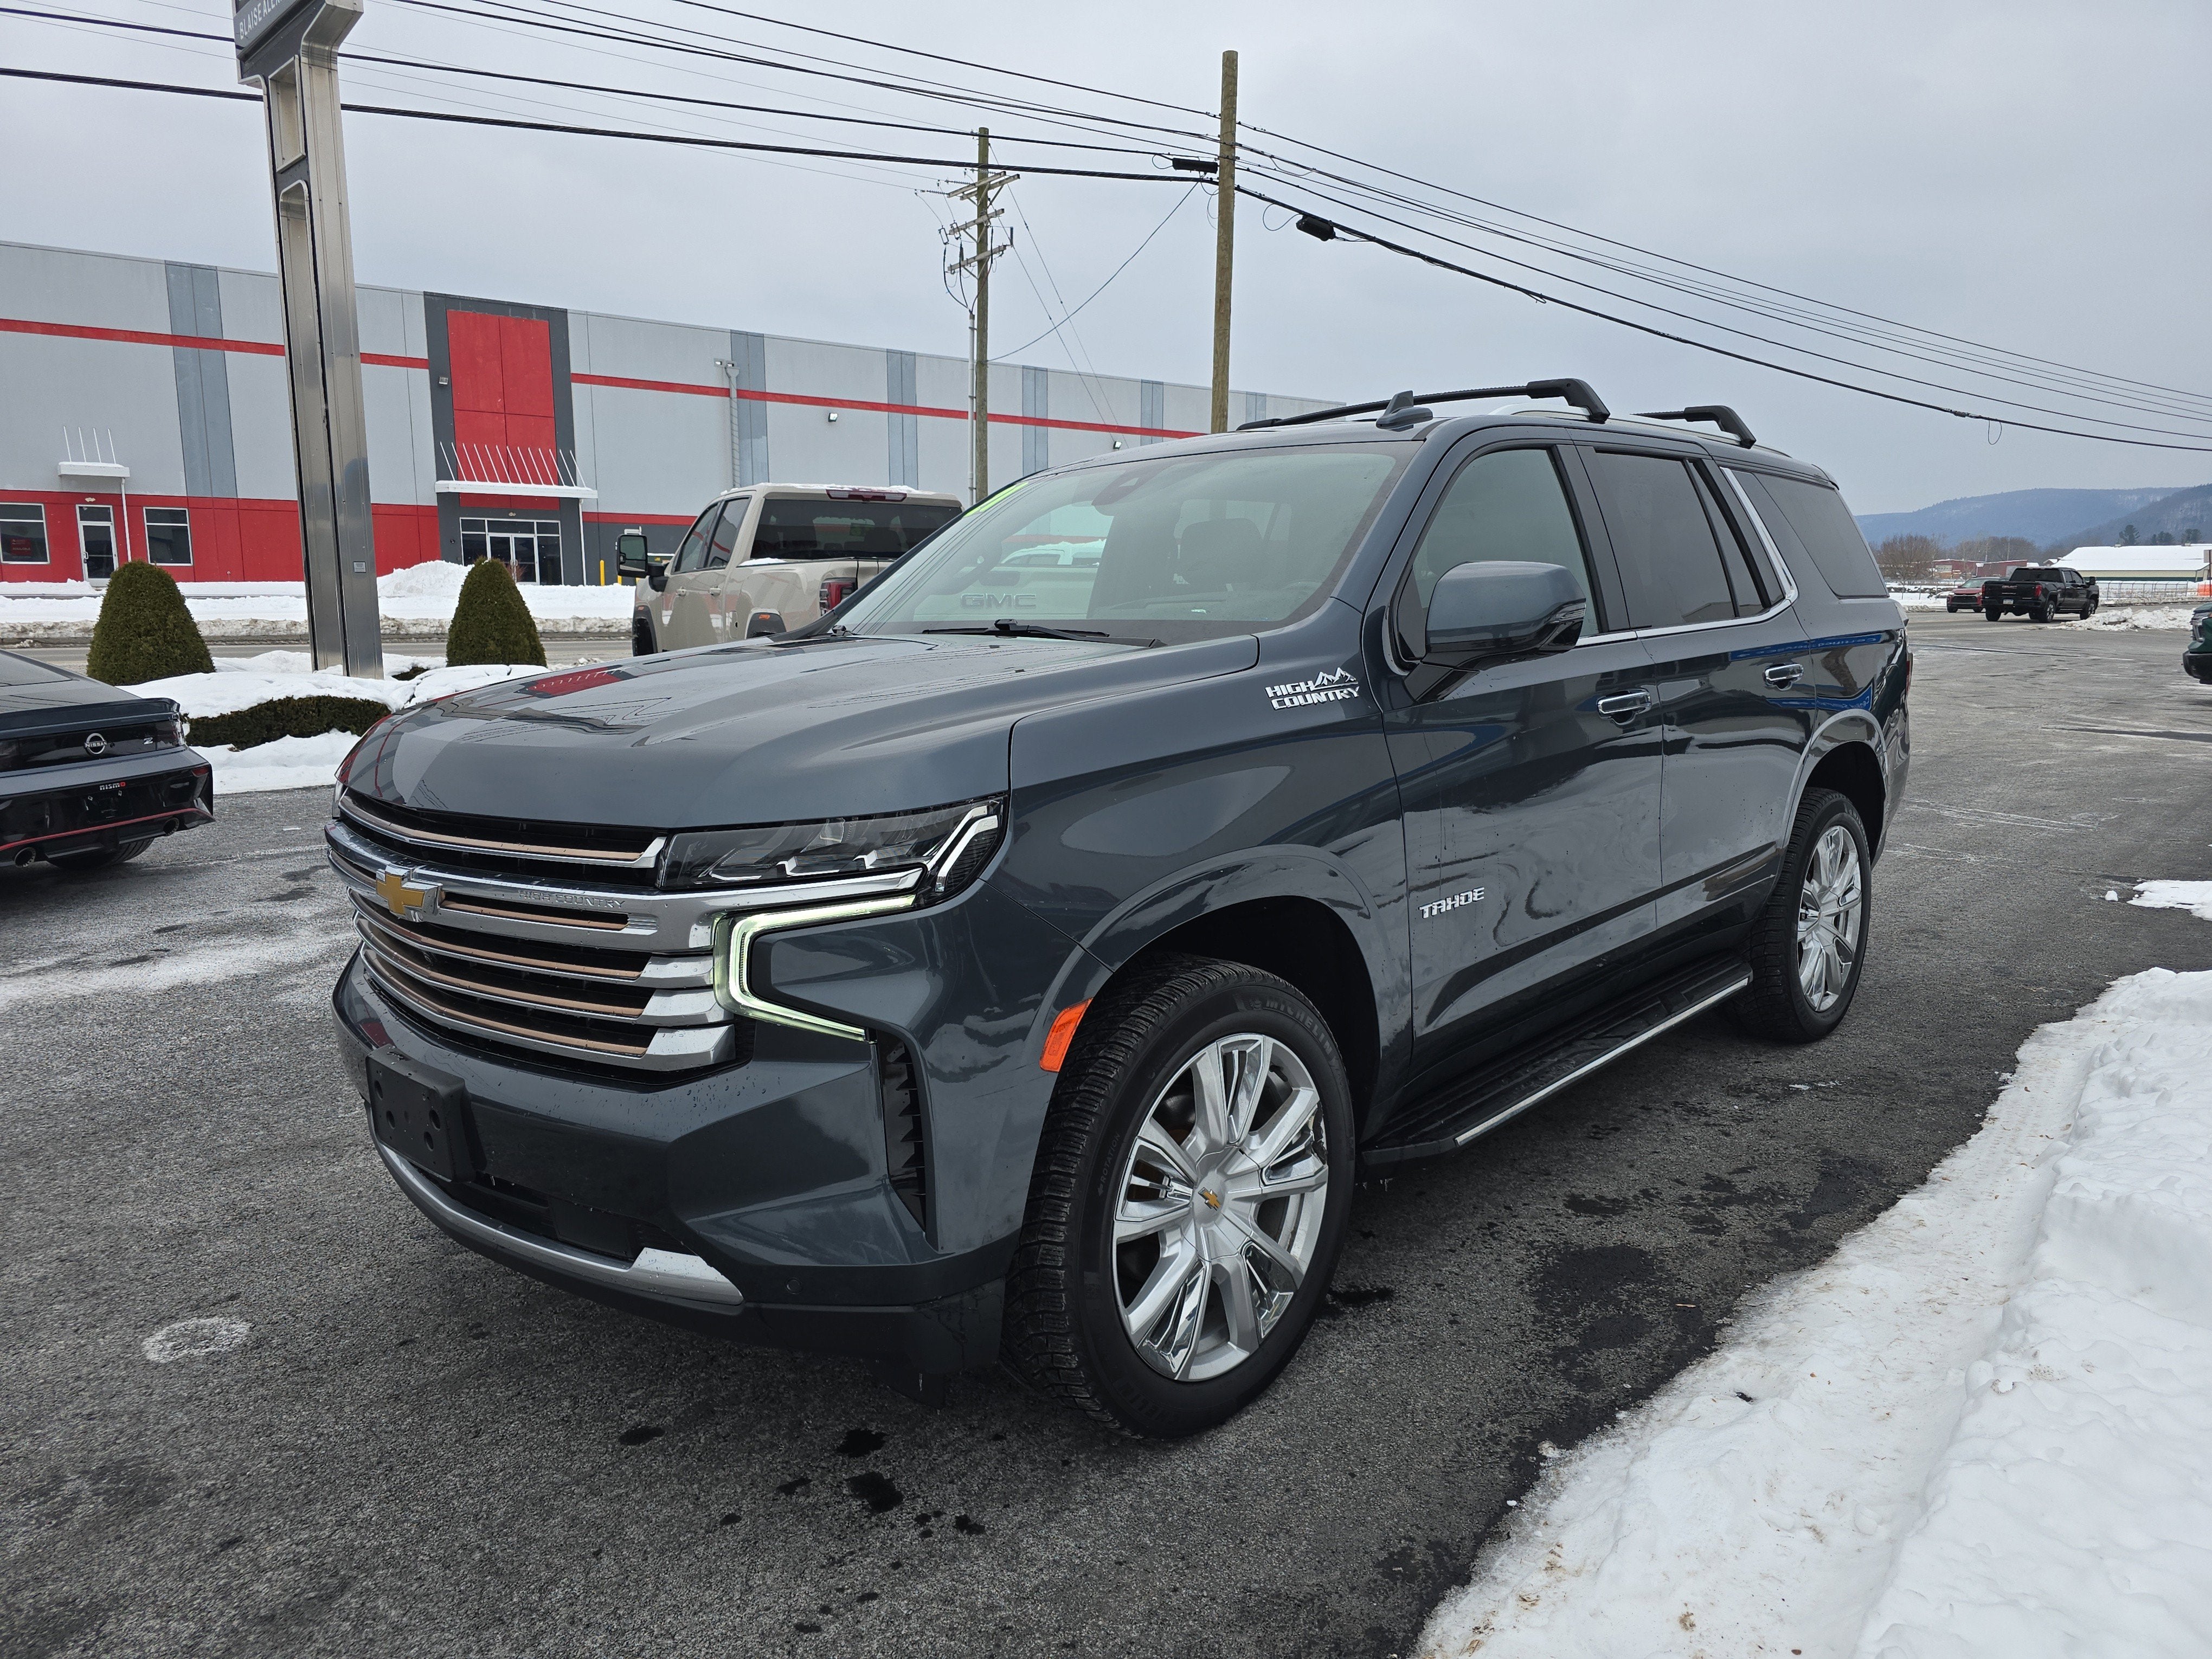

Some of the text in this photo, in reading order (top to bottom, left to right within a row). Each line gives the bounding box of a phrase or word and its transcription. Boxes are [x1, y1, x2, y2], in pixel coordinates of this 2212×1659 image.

[240, 2, 262, 40] BLAISE
[961, 593, 1037, 608] GMC
[1265, 680, 1315, 698] HIGH
[1271, 686, 1360, 710] COUNTRY
[518, 889, 626, 909] HIGH COUNTRY
[1418, 886, 1485, 918] TAHOE
[1265, 1000, 1333, 1055] MICHELIN
[1099, 1132, 1121, 1184] ROTATION
